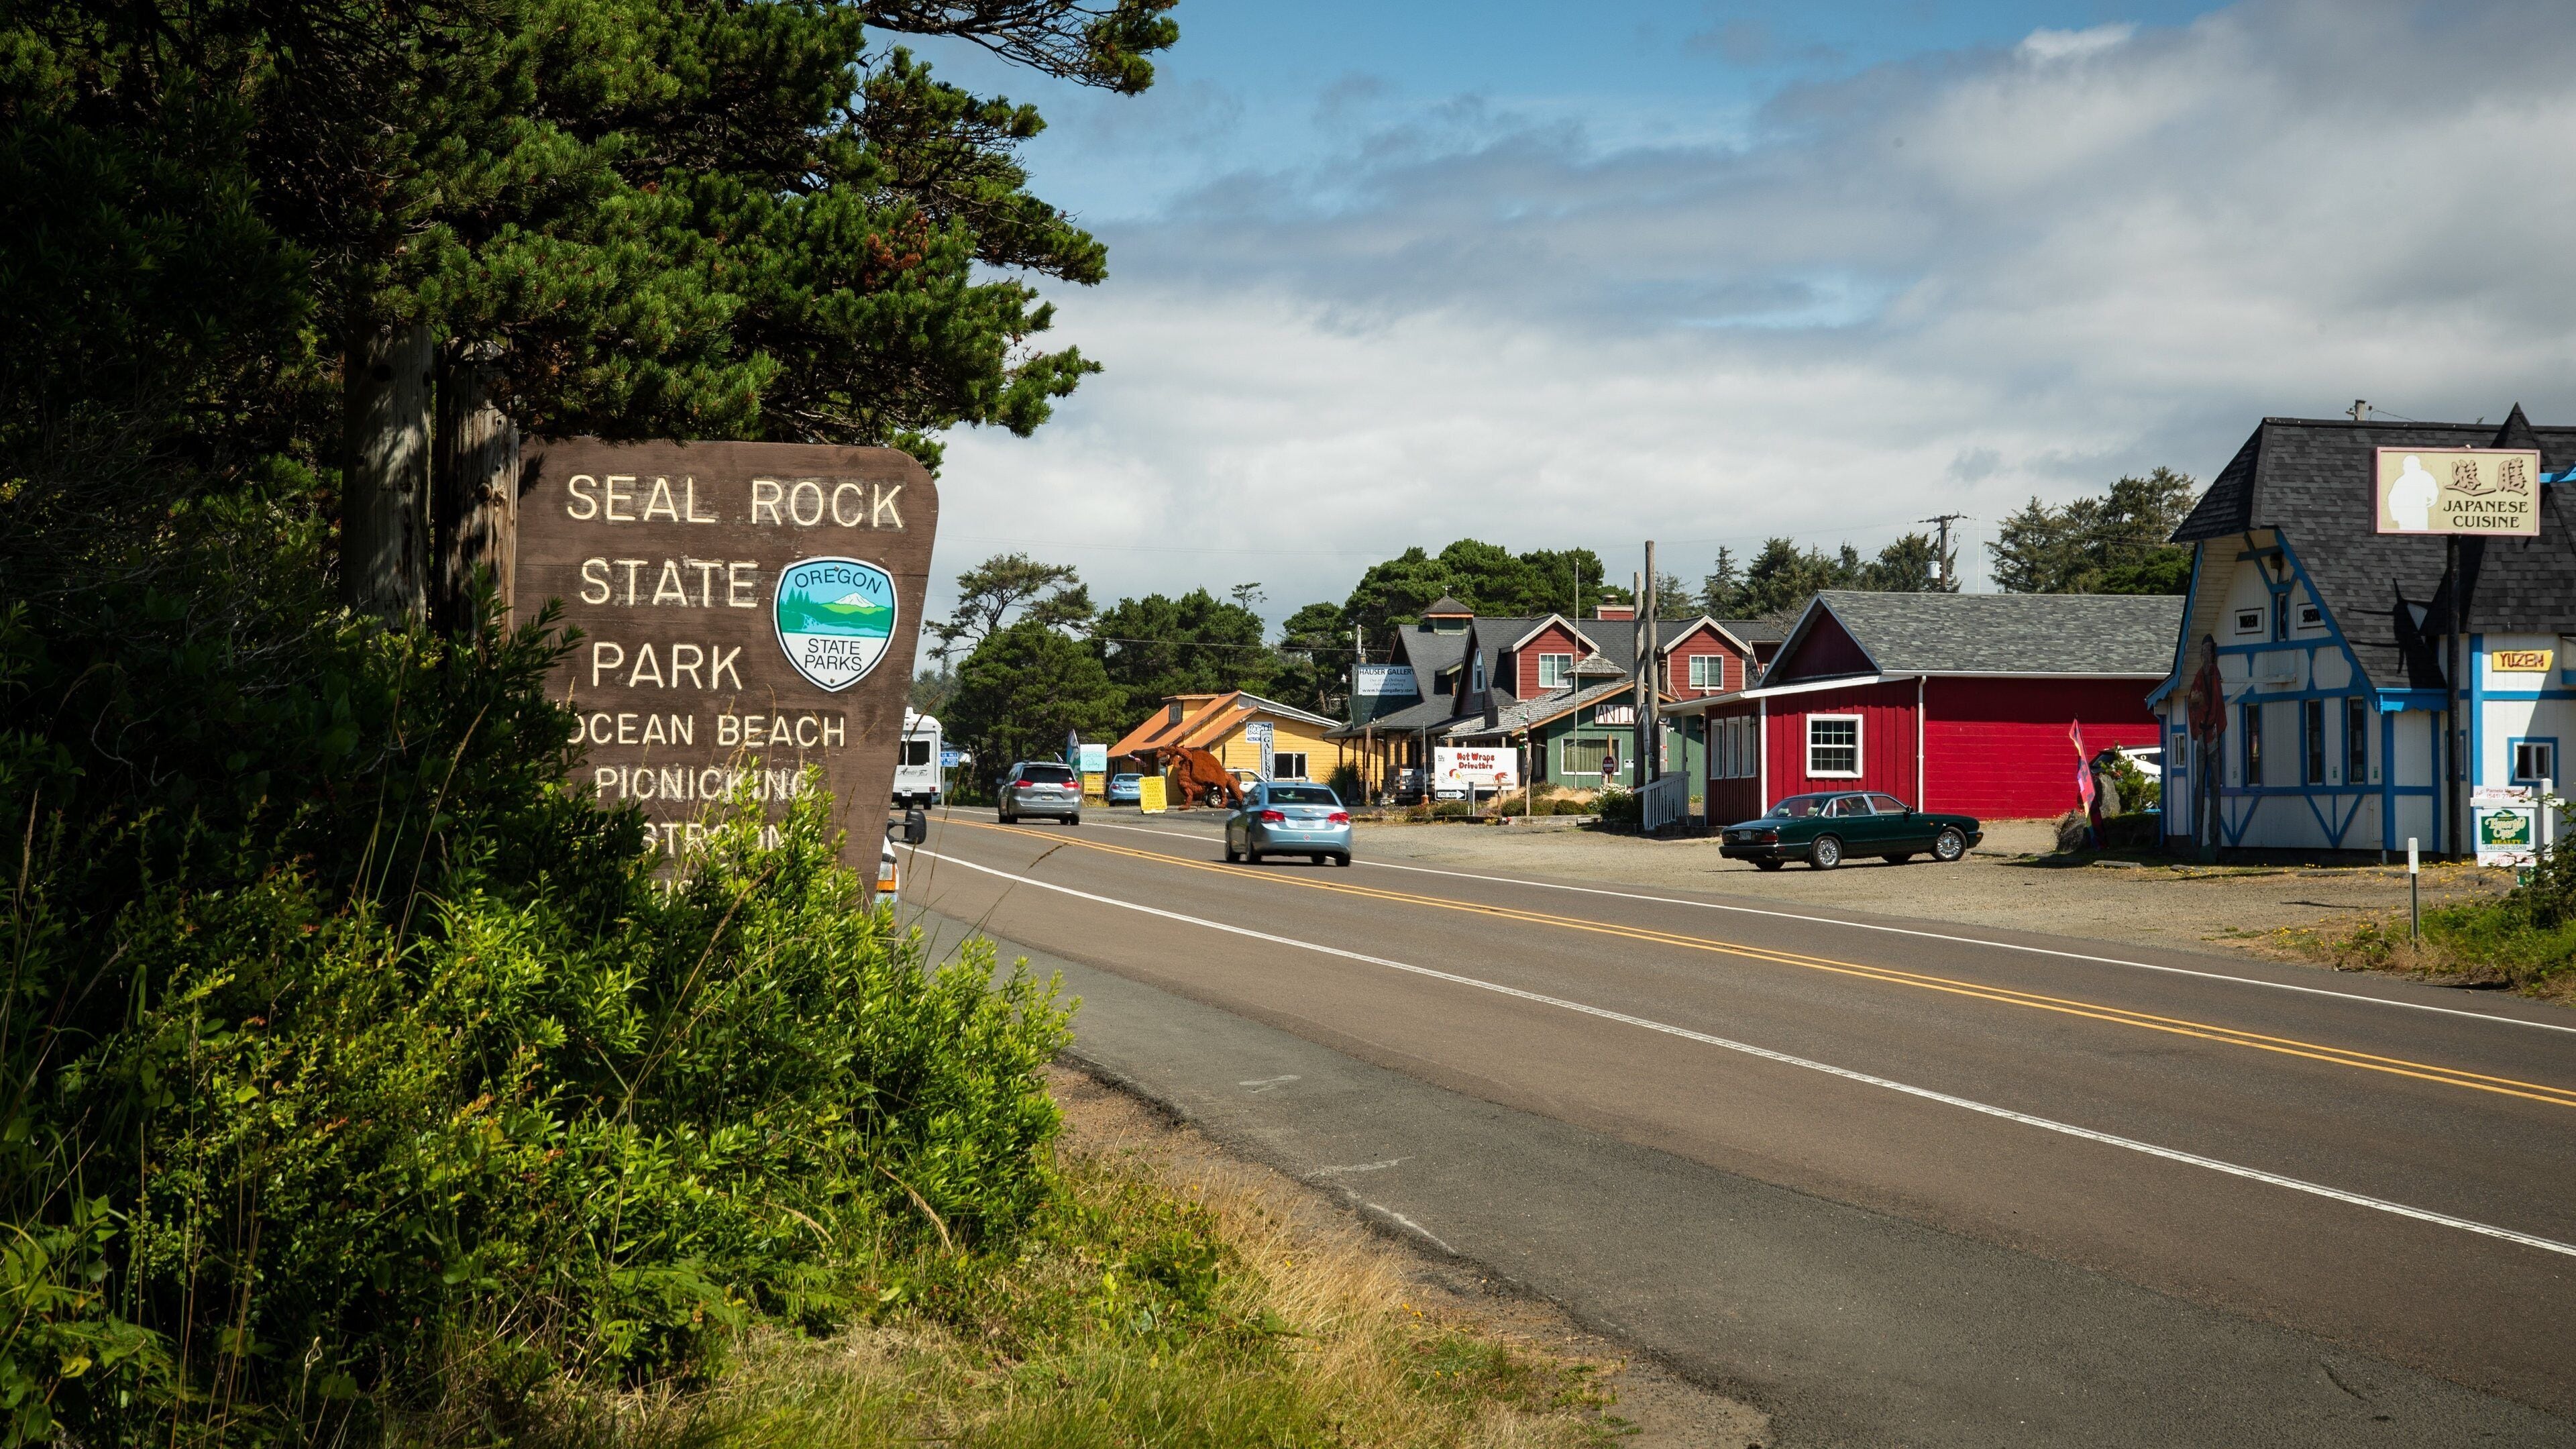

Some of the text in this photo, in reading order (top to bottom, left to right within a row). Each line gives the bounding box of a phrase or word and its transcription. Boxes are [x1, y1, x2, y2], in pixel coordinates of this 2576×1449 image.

[567, 474, 904, 529] SEAL ROCK
[2443, 500, 2528, 513] JAPANESE
[2453, 515, 2520, 528] CUISINE
[580, 557, 759, 608] STATE
[795, 569, 882, 594] OREGON
[808, 638, 861, 655] STATE
[592, 641, 743, 690] PARK
[804, 654, 862, 672] PARKS
[2500, 653, 2544, 667] YUZEN
[718, 714, 845, 747] BEACH
[1263, 737, 1271, 782] GALLERY
[1457, 753, 1495, 763] Hot Wraps
[595, 766, 814, 802] PICNICKING
[2485, 816, 2526, 832] Emerald
